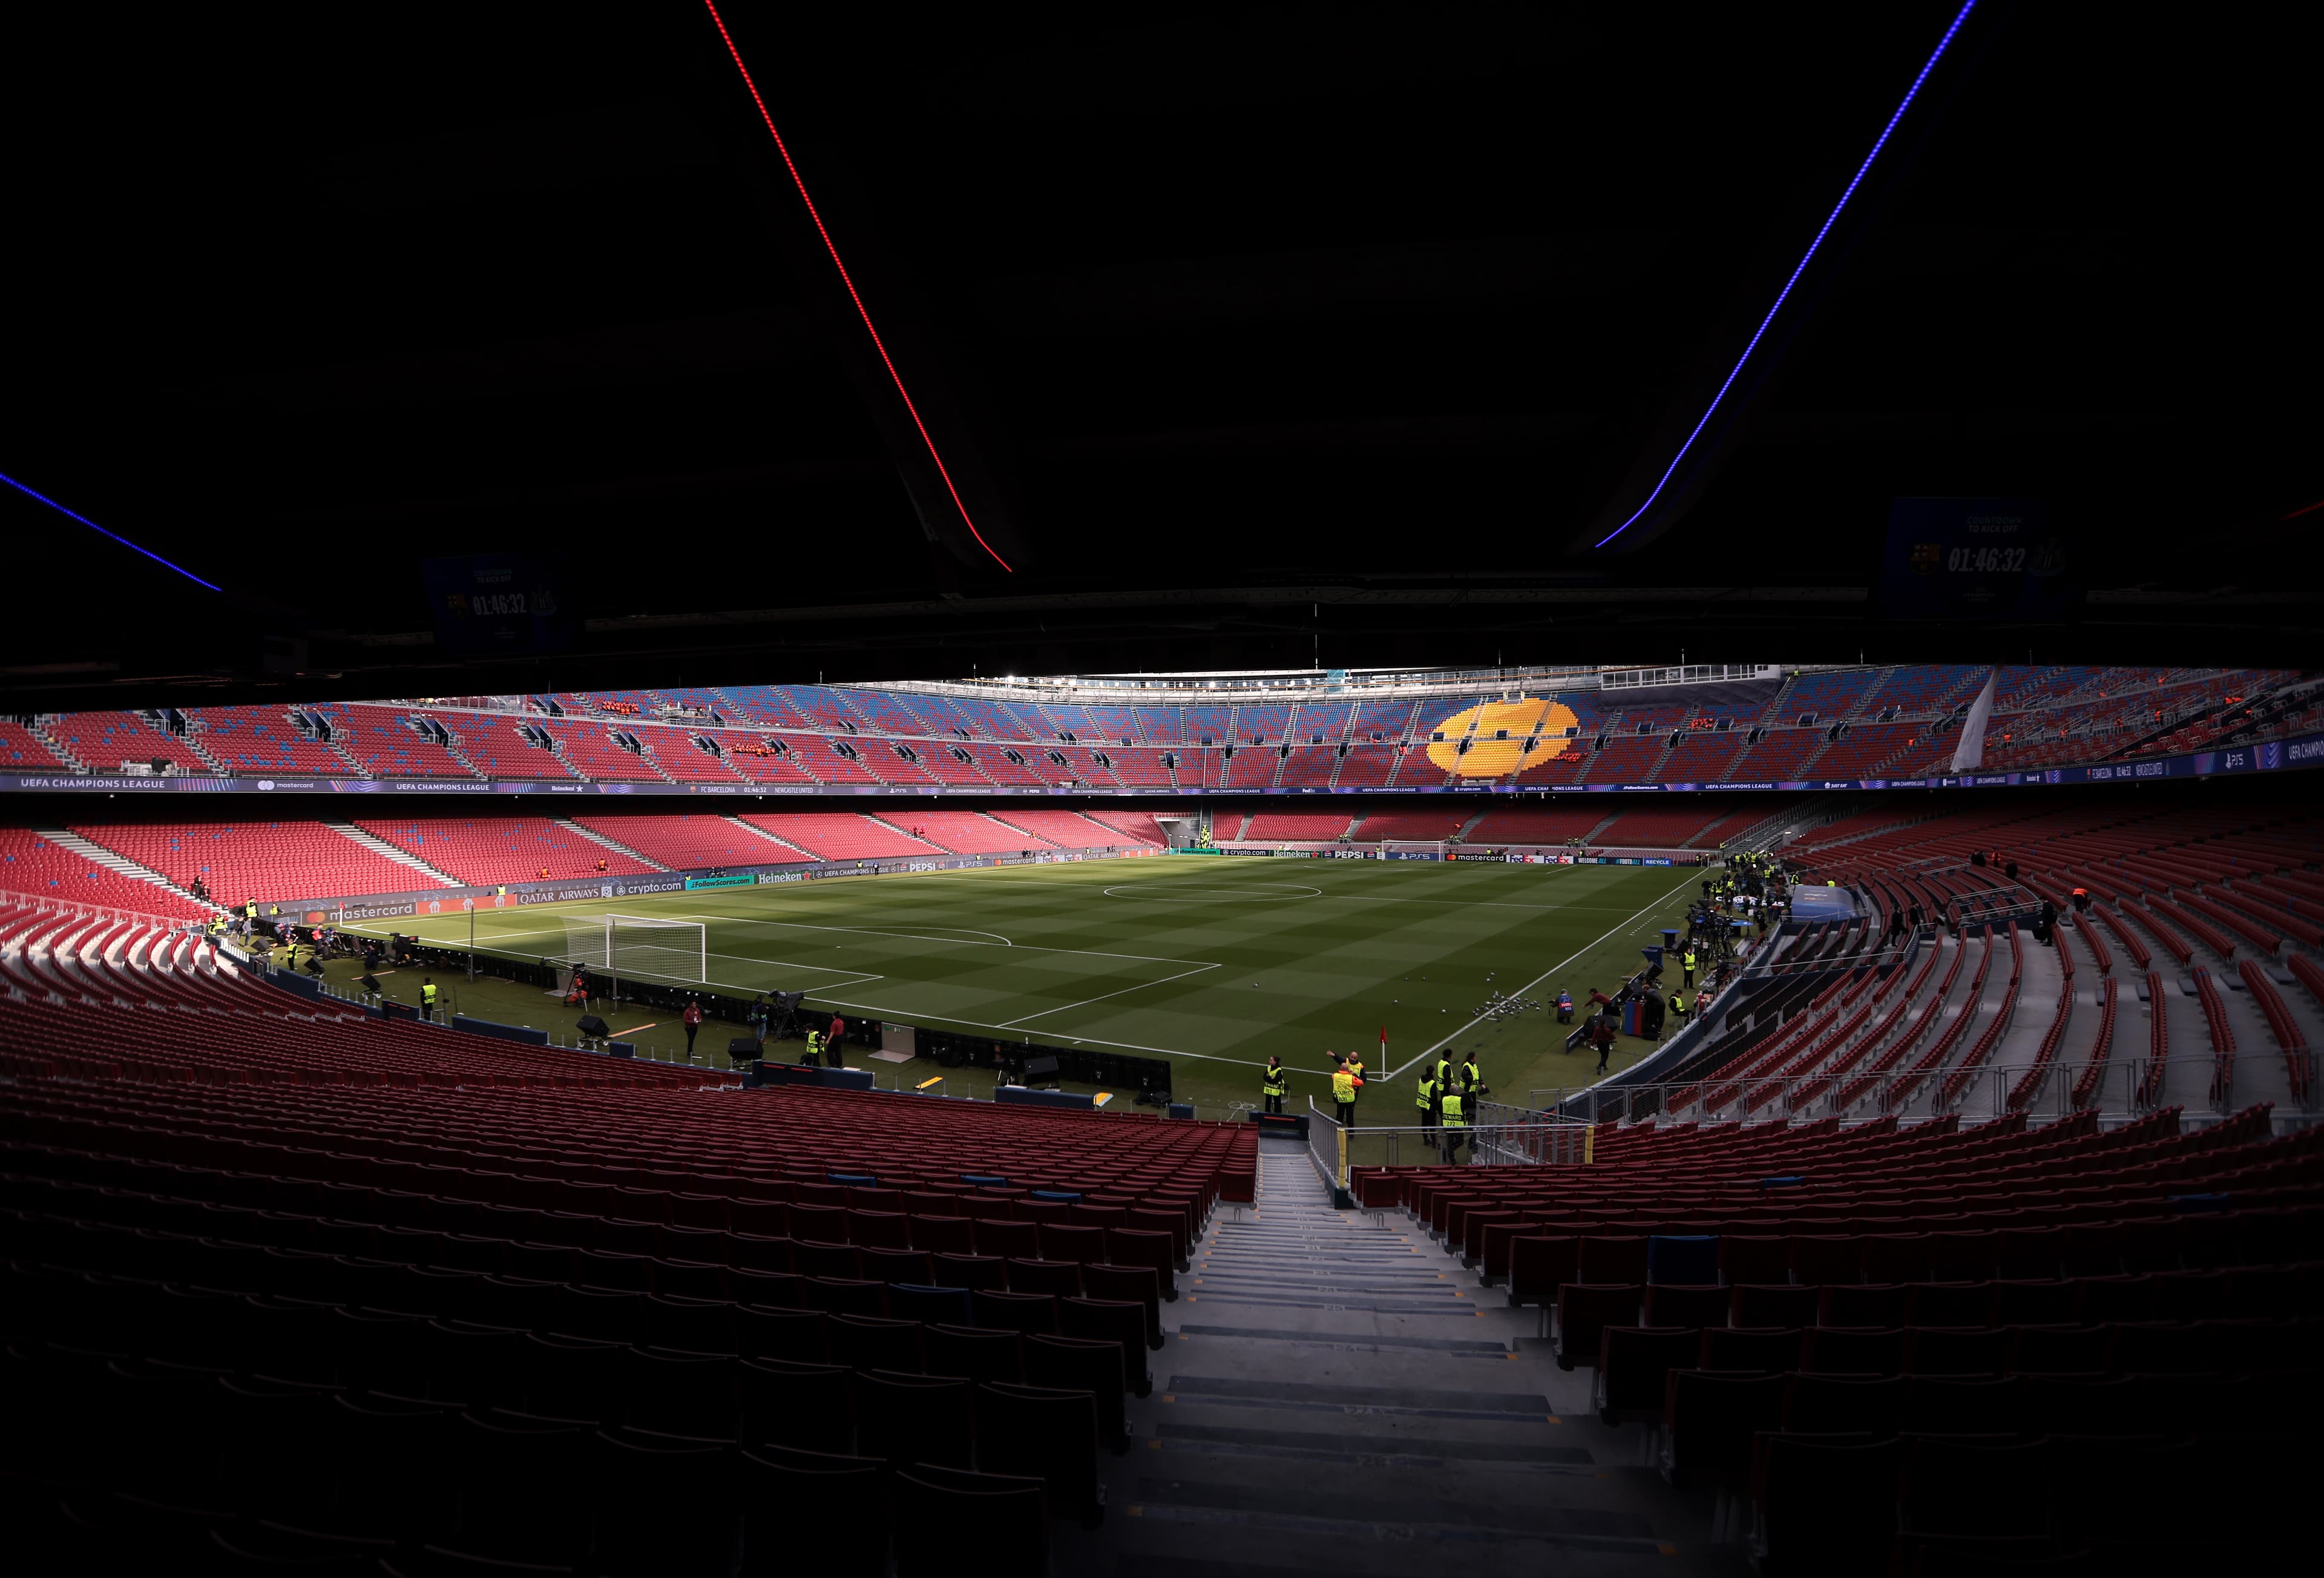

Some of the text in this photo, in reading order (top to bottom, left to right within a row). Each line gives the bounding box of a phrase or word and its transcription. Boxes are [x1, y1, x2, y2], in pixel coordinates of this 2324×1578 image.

[2003, 524, 2019, 533] OFF
[1948, 547, 2026, 571] 01:46:32
[473, 593, 527, 615] 01:46:32
[2289, 745, 2301, 760] UEFA
[21, 778, 49, 787] UEFA
[53, 780, 120, 788] CHAMPIONS
[1002, 856, 1036, 865] mastercard
[1273, 850, 1310, 858] Heineken
[1334, 850, 1364, 859] PEPSI
[909, 862, 936, 872] PEPSI
[758, 872, 802, 885] Heineken
[628, 880, 681, 894] crypto.com
[520, 888, 599, 905] QATAR AIRWAYS
[330, 904, 412, 920] mastercard
